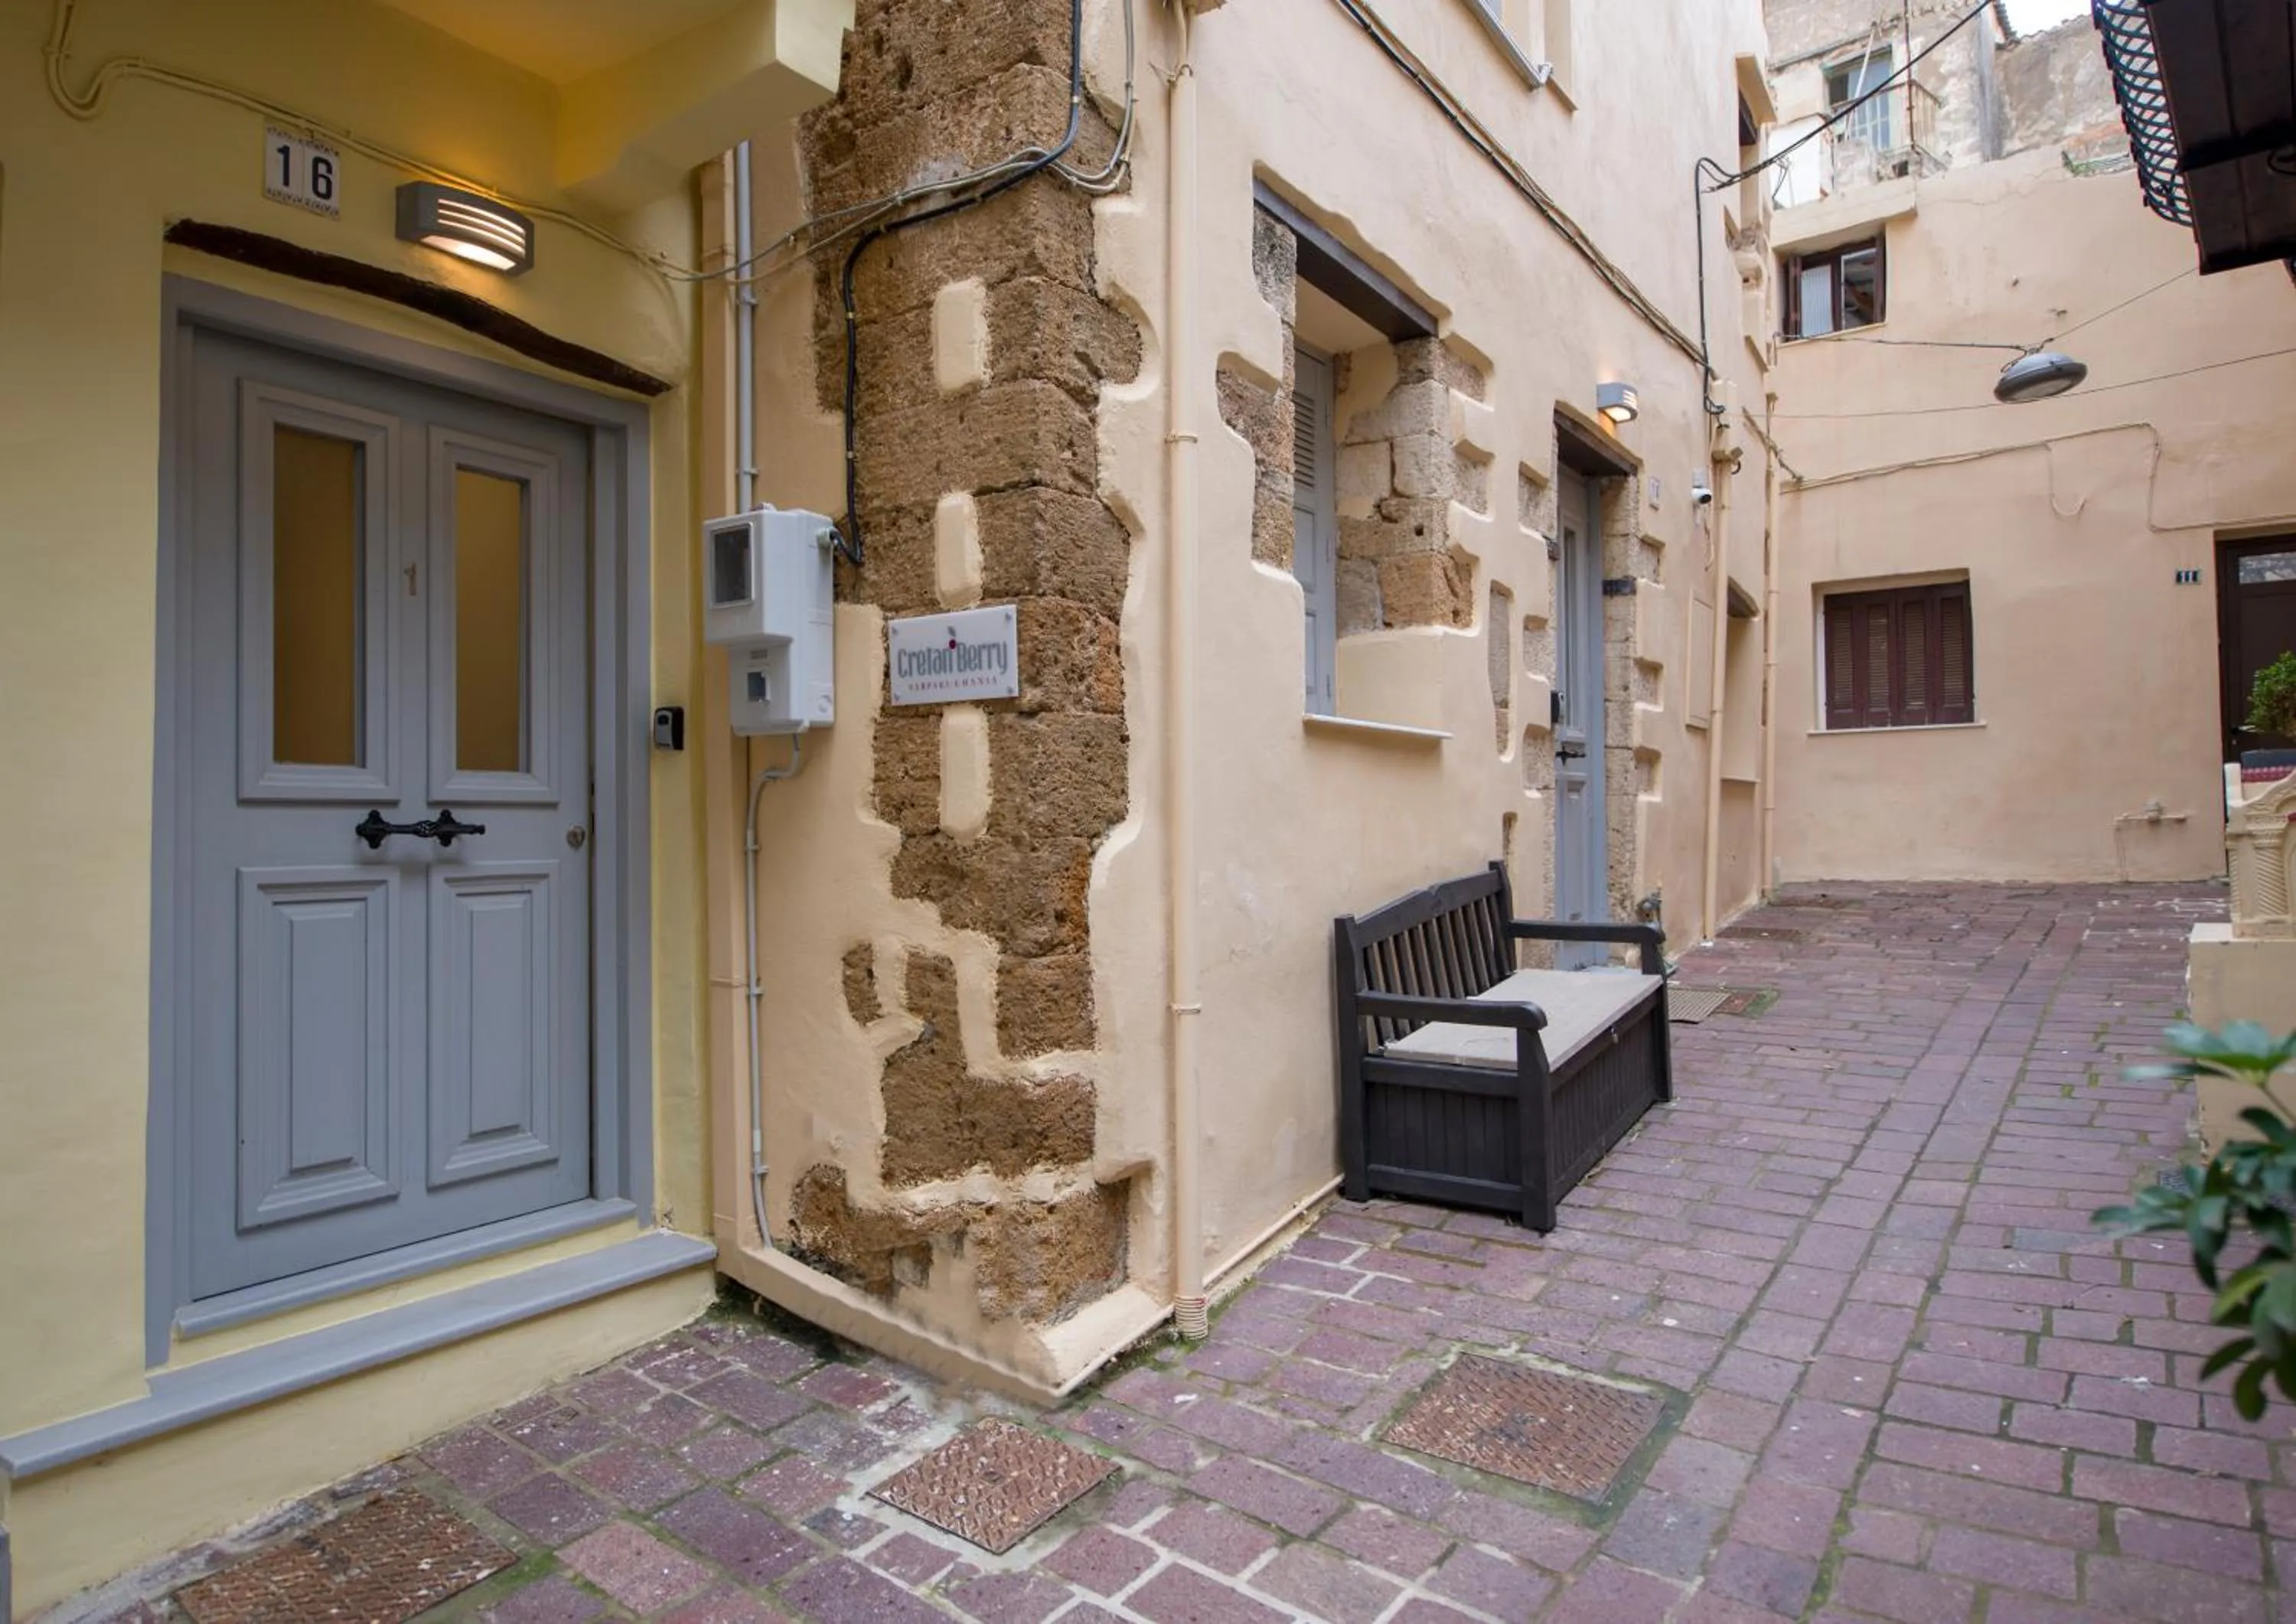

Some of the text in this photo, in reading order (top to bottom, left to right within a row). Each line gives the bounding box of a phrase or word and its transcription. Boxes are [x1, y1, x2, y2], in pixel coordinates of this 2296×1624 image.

[276, 145, 333, 201] 16
[897, 640, 1008, 679] Cretan Berry
